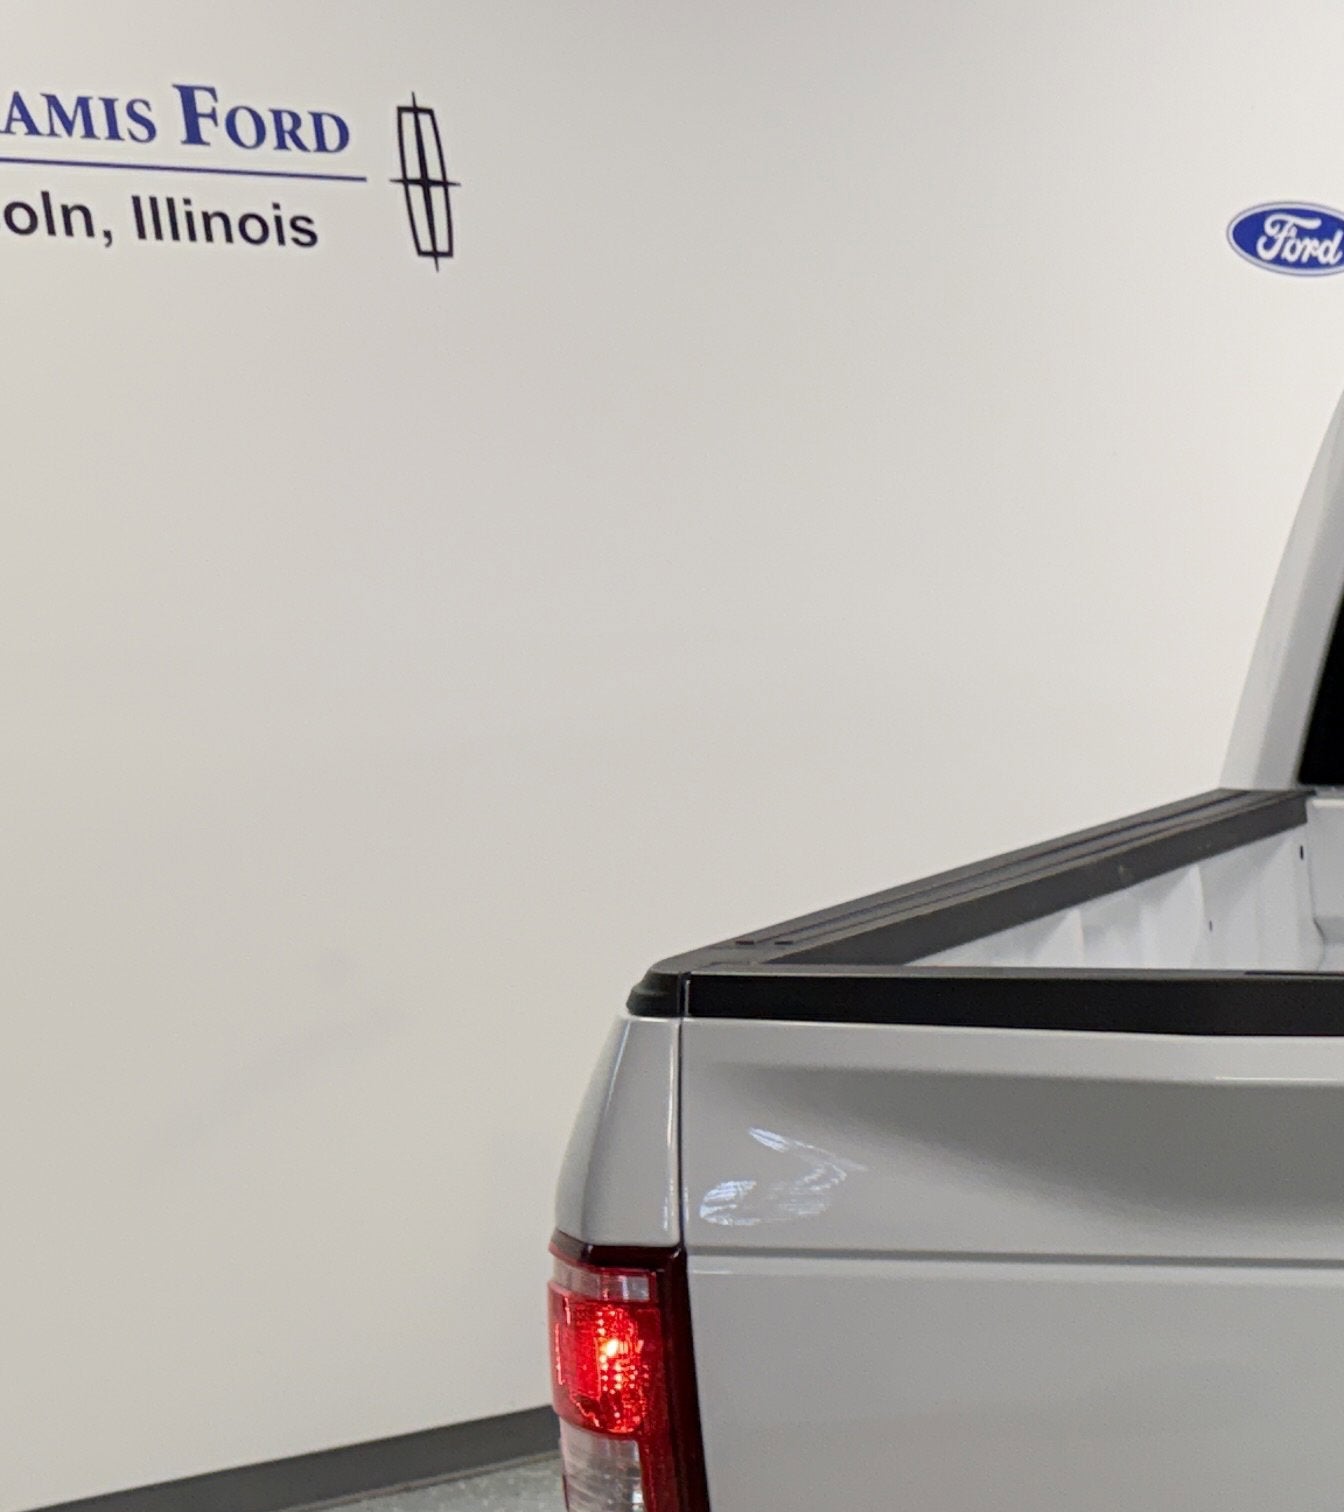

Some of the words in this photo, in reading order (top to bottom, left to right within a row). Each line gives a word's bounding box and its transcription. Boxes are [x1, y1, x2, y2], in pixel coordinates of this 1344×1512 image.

[0, 90, 158, 144] AMIS
[172, 83, 351, 154] FORD
[131, 195, 319, 248] Illinois
[1256, 212, 1344, 266] Ford
